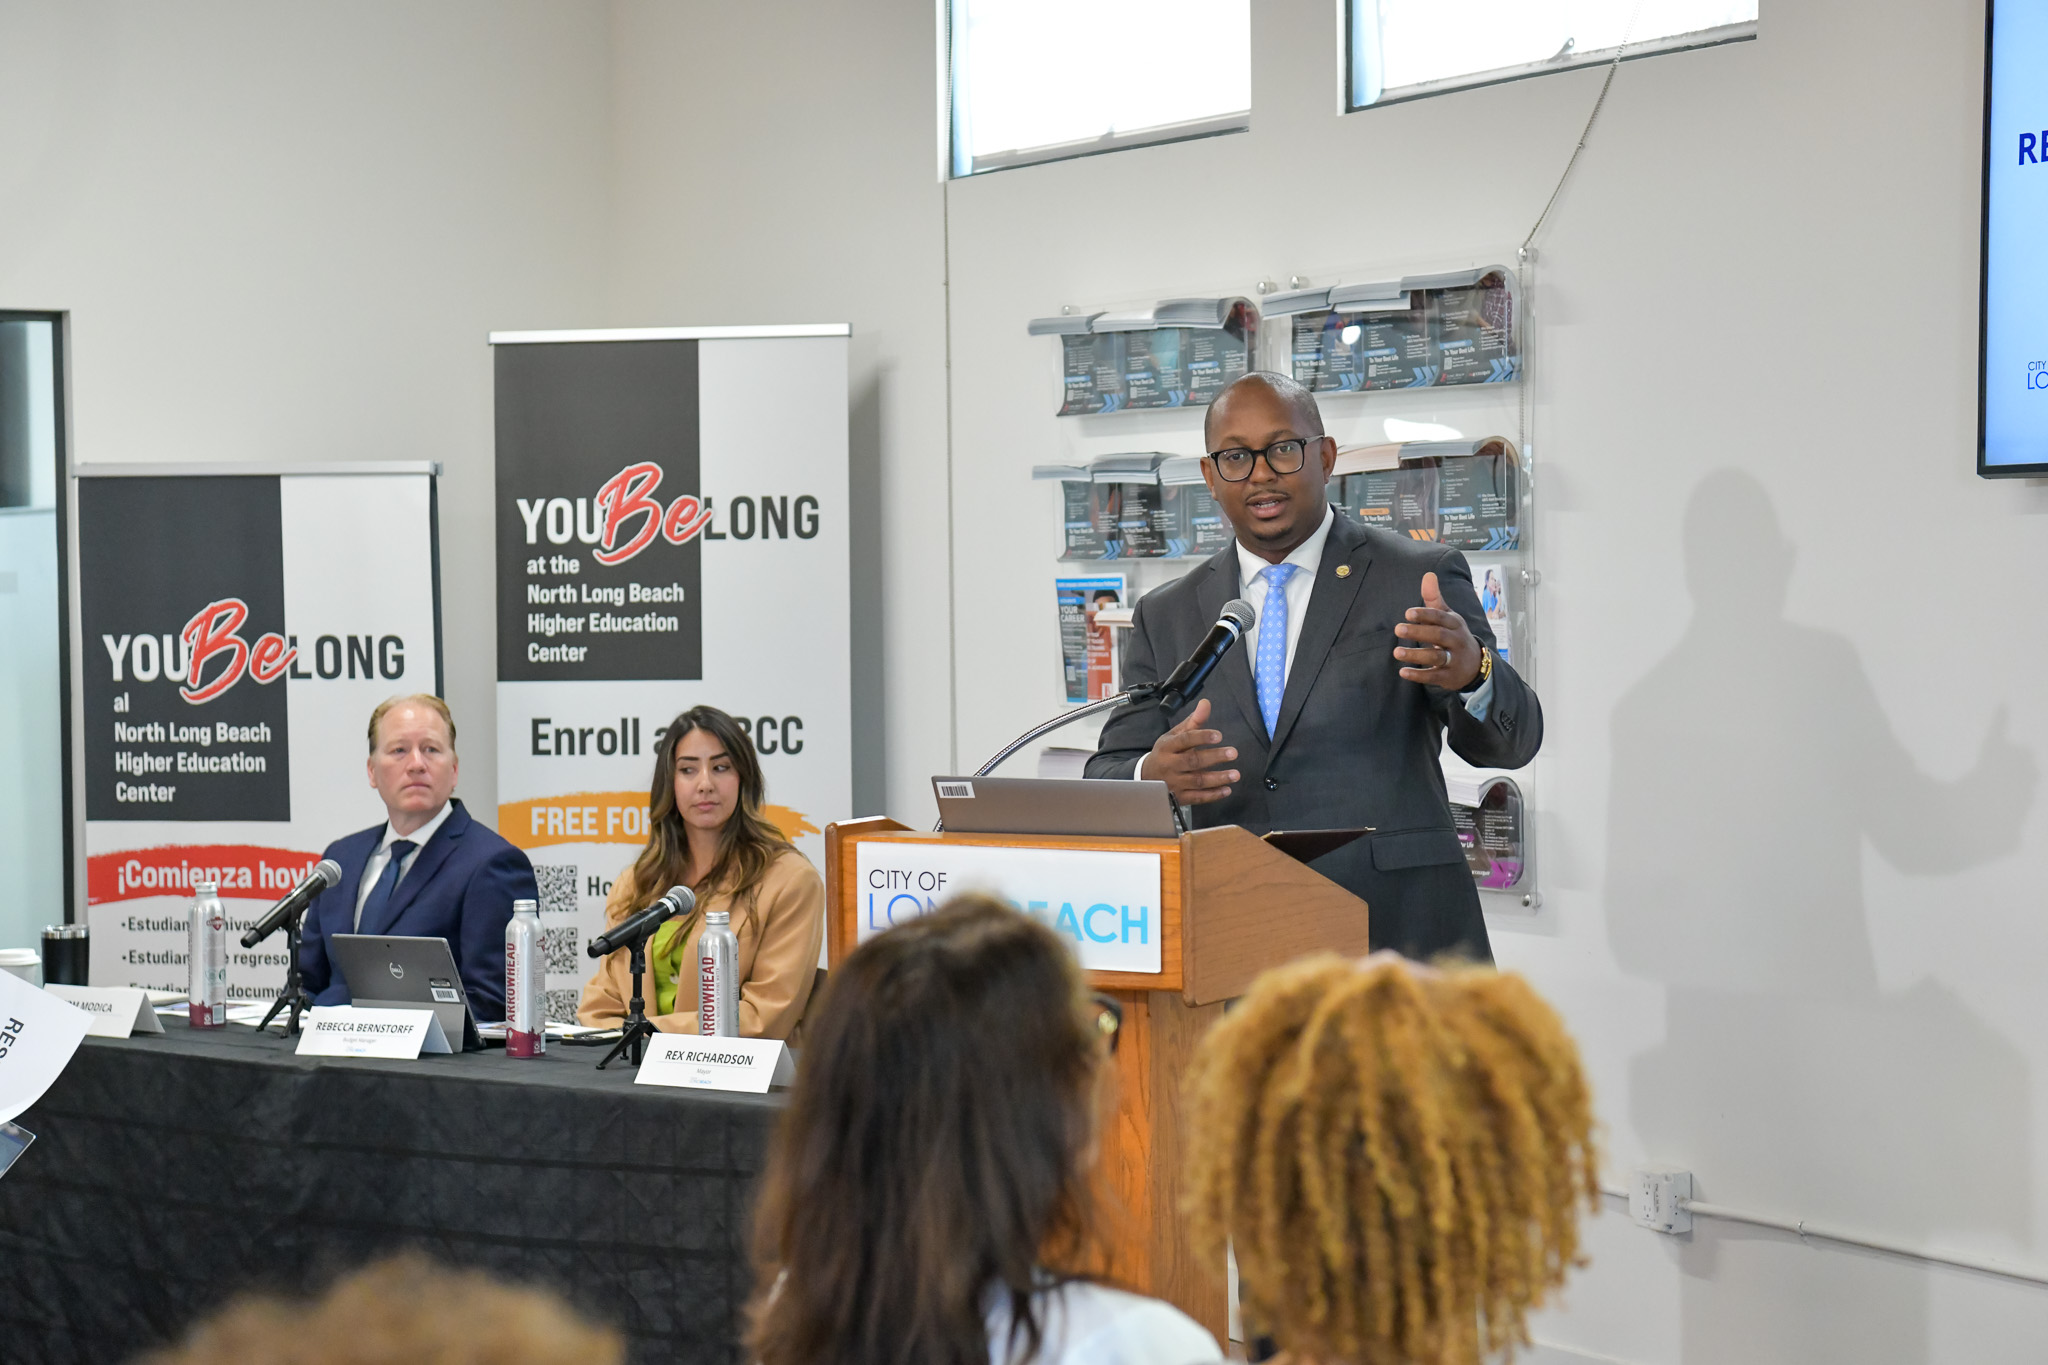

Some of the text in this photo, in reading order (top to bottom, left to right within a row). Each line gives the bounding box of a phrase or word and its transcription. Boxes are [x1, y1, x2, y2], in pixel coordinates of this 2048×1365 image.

[2019, 130, 2048, 165] RE
[2027, 361, 2046, 371] CITY
[2027, 371, 2048, 390] LO
[527, 555, 580, 575] at the
[527, 583, 685, 607] North Long Beach
[528, 612, 679, 636] Higher Education
[527, 643, 588, 662] Center
[113, 692, 130, 713] al
[114, 722, 271, 746] North Long Beach
[531, 717, 640, 756] Enroll
[653, 726, 668, 756] a
[115, 752, 266, 776] Higher Education
[116, 782, 176, 802] Center
[531, 806, 599, 837] FREE
[118, 859, 253, 895] ¡Comienza
[588, 876, 613, 896] Ho
[869, 869, 947, 891] CITY OF
[128, 916, 190, 931] Estudian
[129, 950, 289, 968] Estudian regreso
[506, 943, 516, 1023] ARROWHEAD
[80, 1001, 113, 1013] MODICA
[316, 1022, 414, 1034] REBECCA BERNSTORFF
[665, 1050, 754, 1066] REX RICHARDSON
